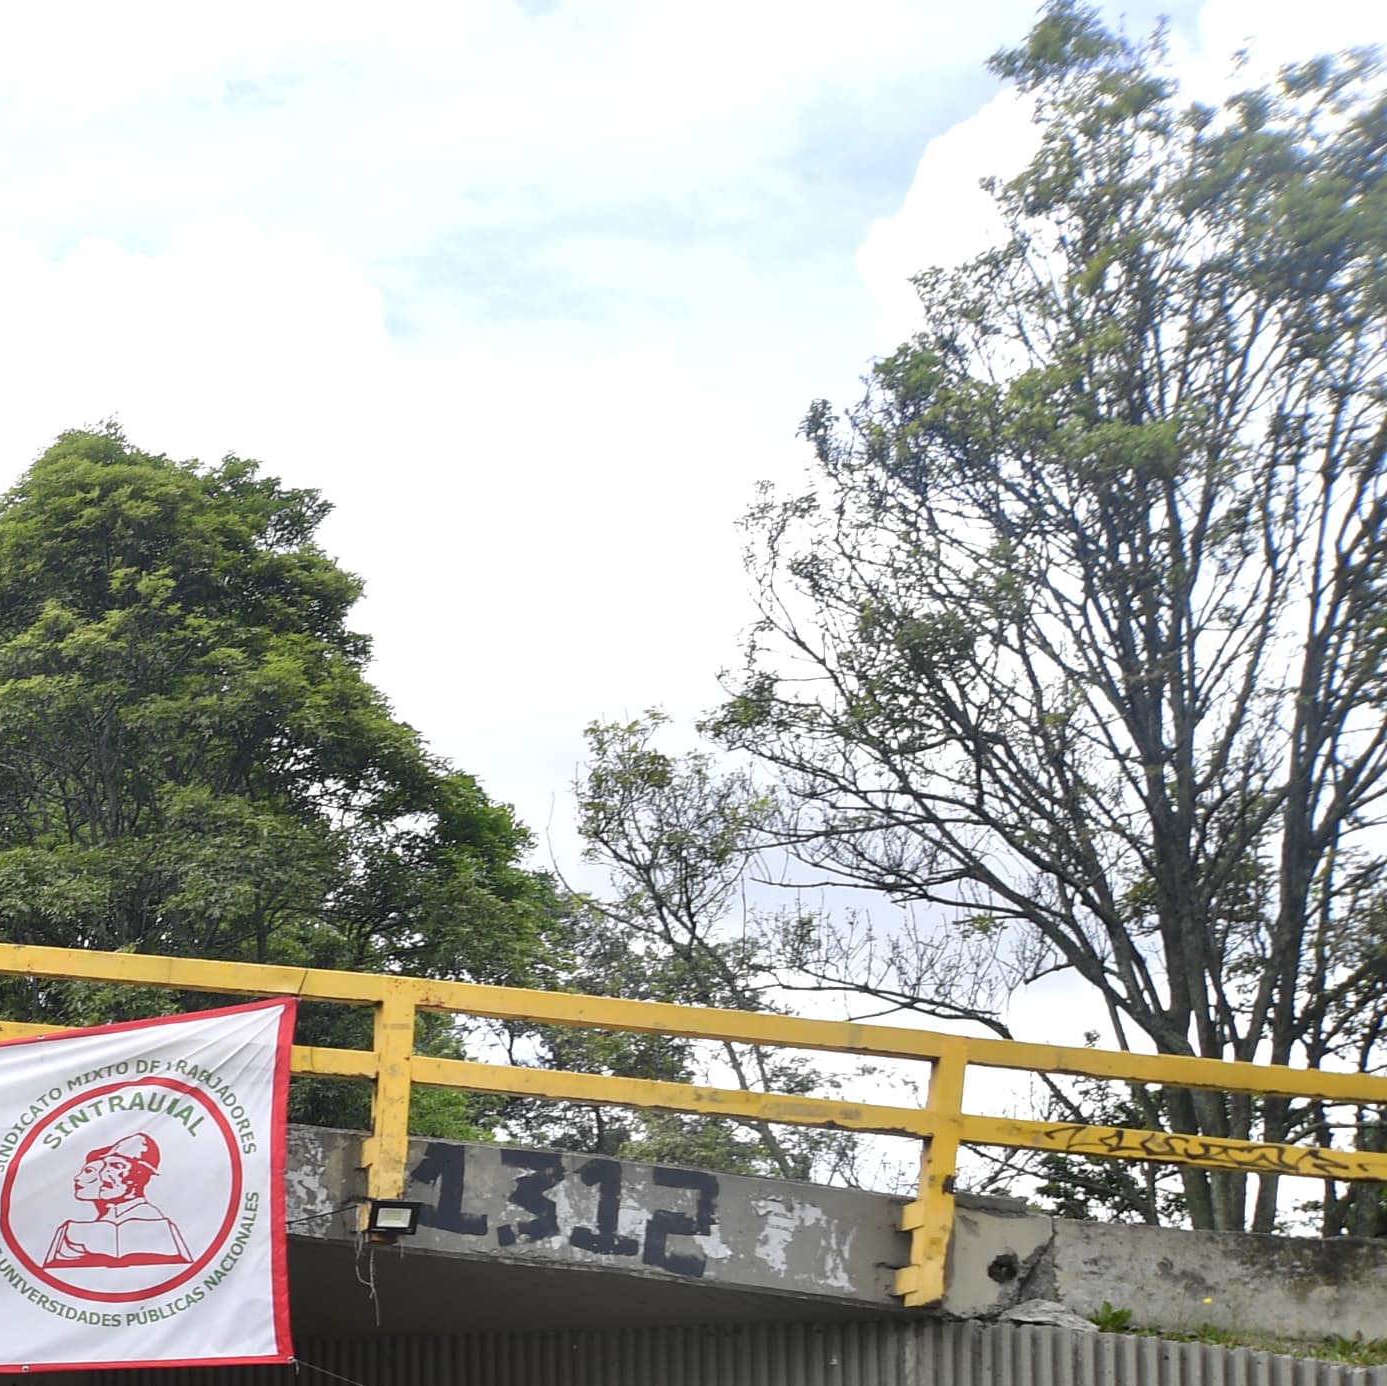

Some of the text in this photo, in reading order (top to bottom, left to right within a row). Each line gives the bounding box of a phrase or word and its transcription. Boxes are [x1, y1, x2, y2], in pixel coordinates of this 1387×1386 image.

[67, 1061, 129, 1092] MIXTO
[126, 1288, 205, 1327] PÚBLICAS
[204, 1191, 259, 1290] NACIONALES
[411, 1142, 721, 1278] 1312
